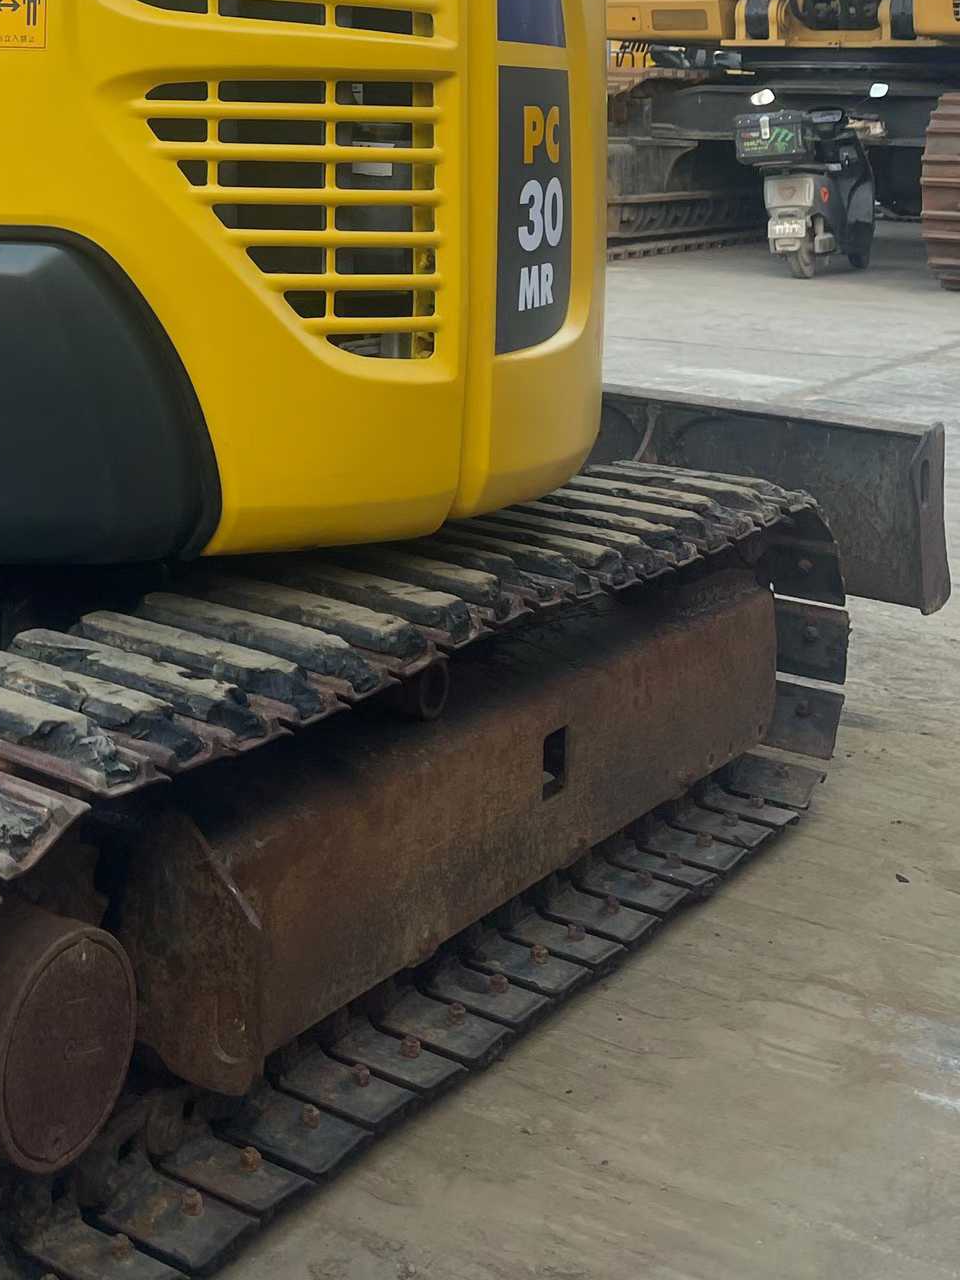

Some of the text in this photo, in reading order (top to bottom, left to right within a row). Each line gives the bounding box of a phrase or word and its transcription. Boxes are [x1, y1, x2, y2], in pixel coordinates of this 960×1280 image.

[523, 106, 560, 164] PC
[518, 176, 563, 252] 30
[518, 262, 554, 311] MR
